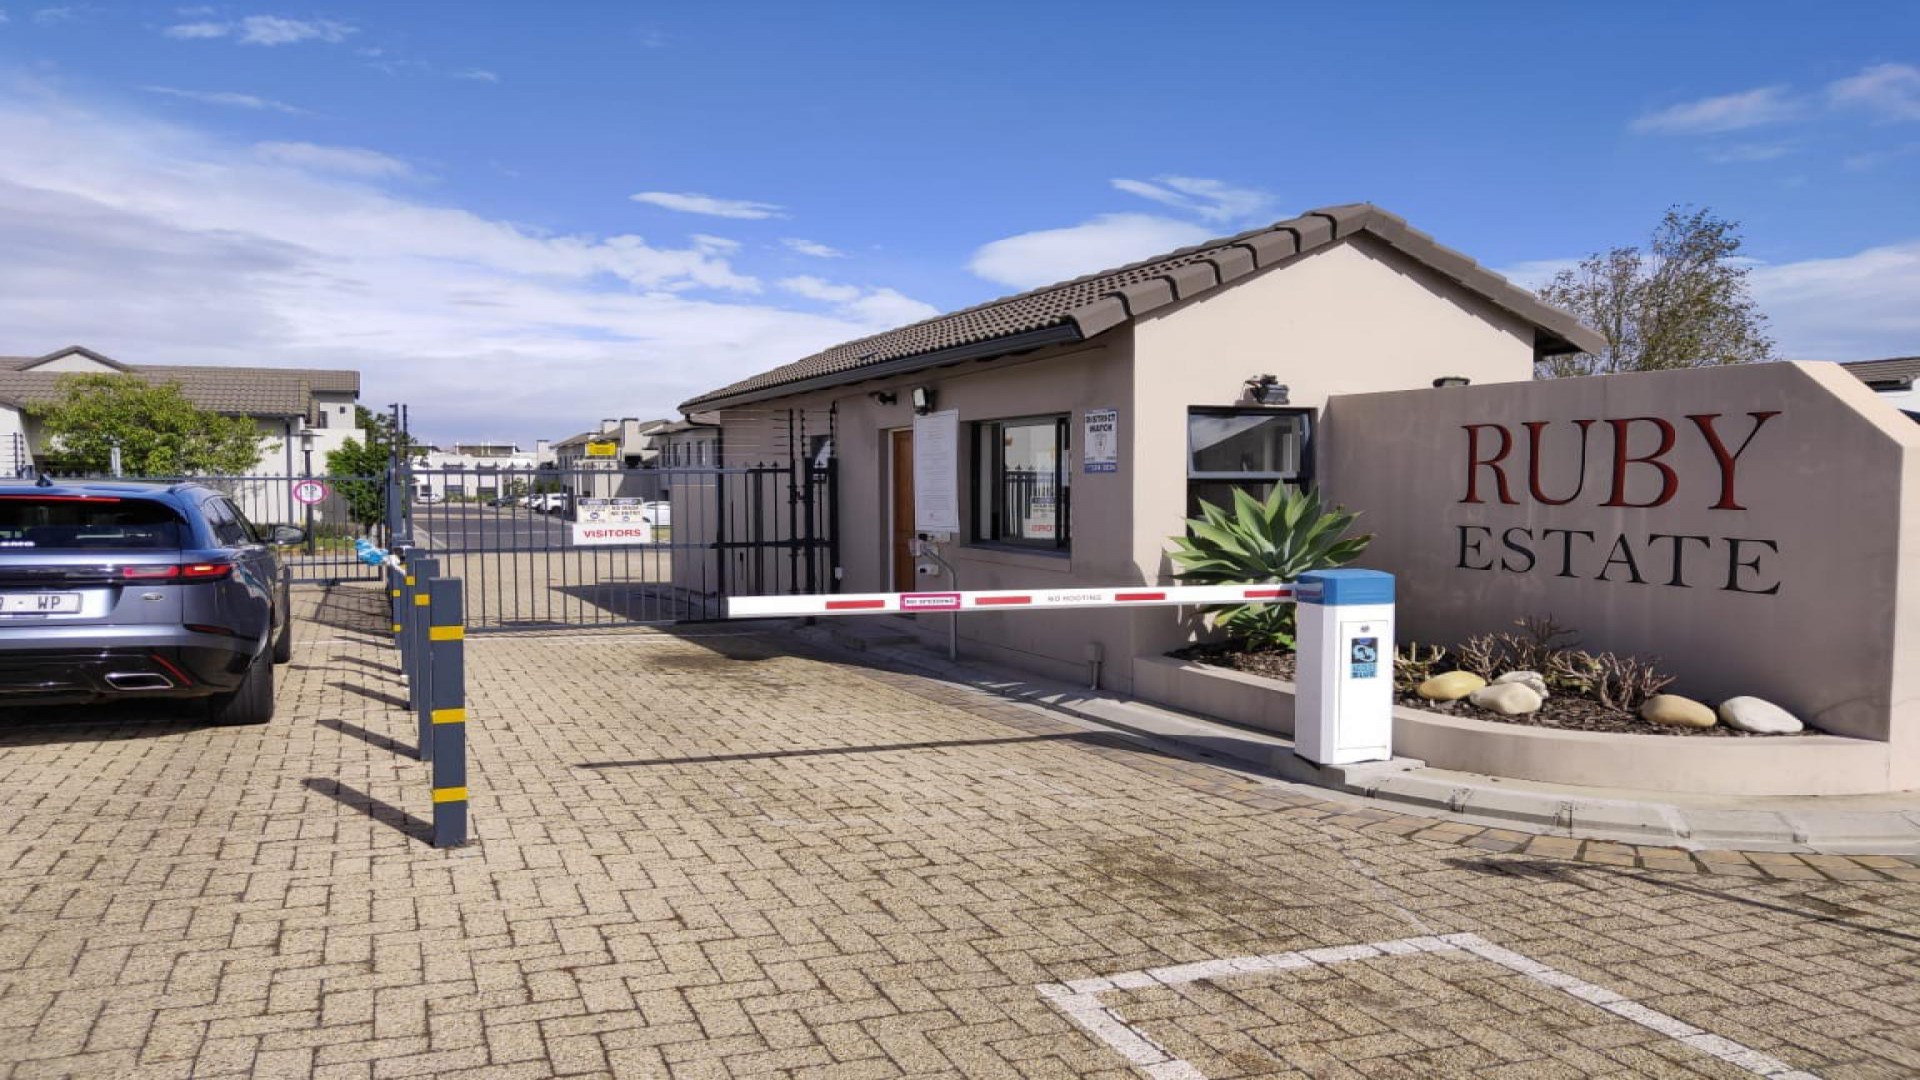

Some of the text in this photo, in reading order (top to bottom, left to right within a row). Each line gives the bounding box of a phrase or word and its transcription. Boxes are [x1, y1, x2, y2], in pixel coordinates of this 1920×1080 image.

[1089, 423, 1113, 432] WATCH
[1456, 410, 1783, 511] RUBY
[584, 529, 641, 538] VISITORS
[1455, 524, 1782, 596] ESTATE
[37, 595, 61, 610] WP
